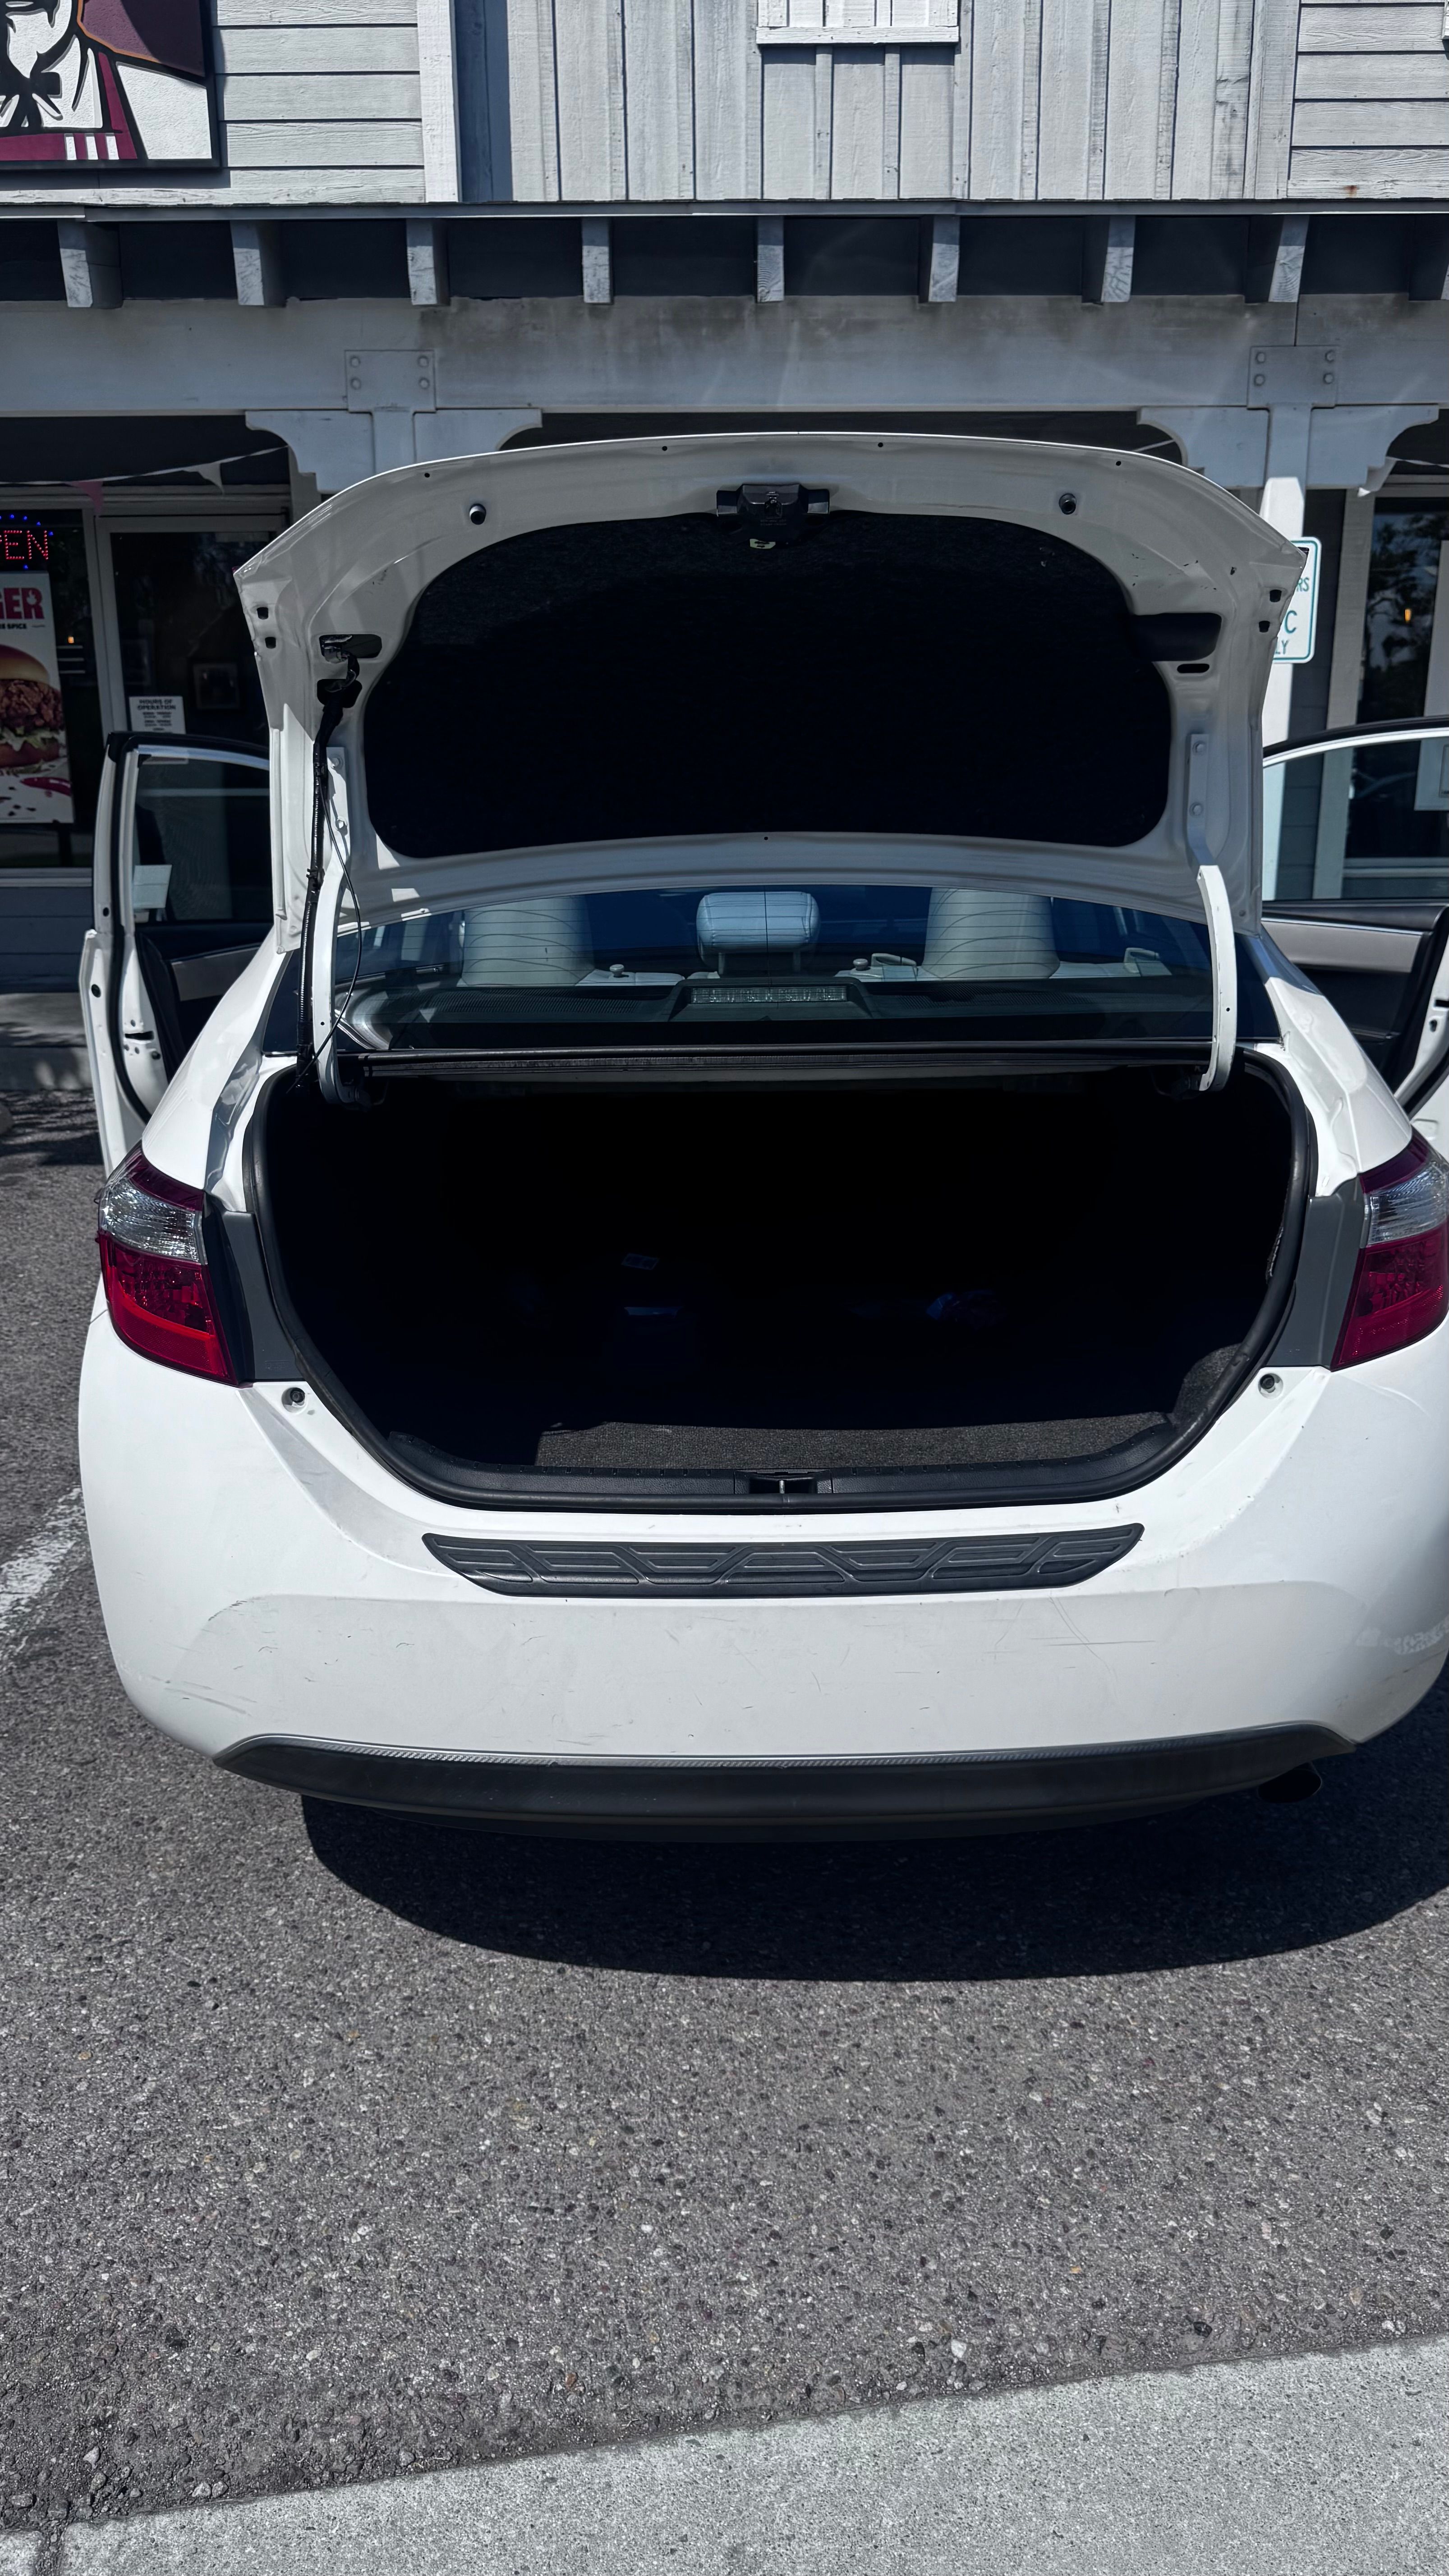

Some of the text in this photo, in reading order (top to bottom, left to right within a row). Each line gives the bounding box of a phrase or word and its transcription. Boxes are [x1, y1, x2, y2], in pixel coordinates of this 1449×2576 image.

[0, 530, 48, 560] EN
[0, 588, 45, 619] ER
[1285, 610, 1297, 633] C
